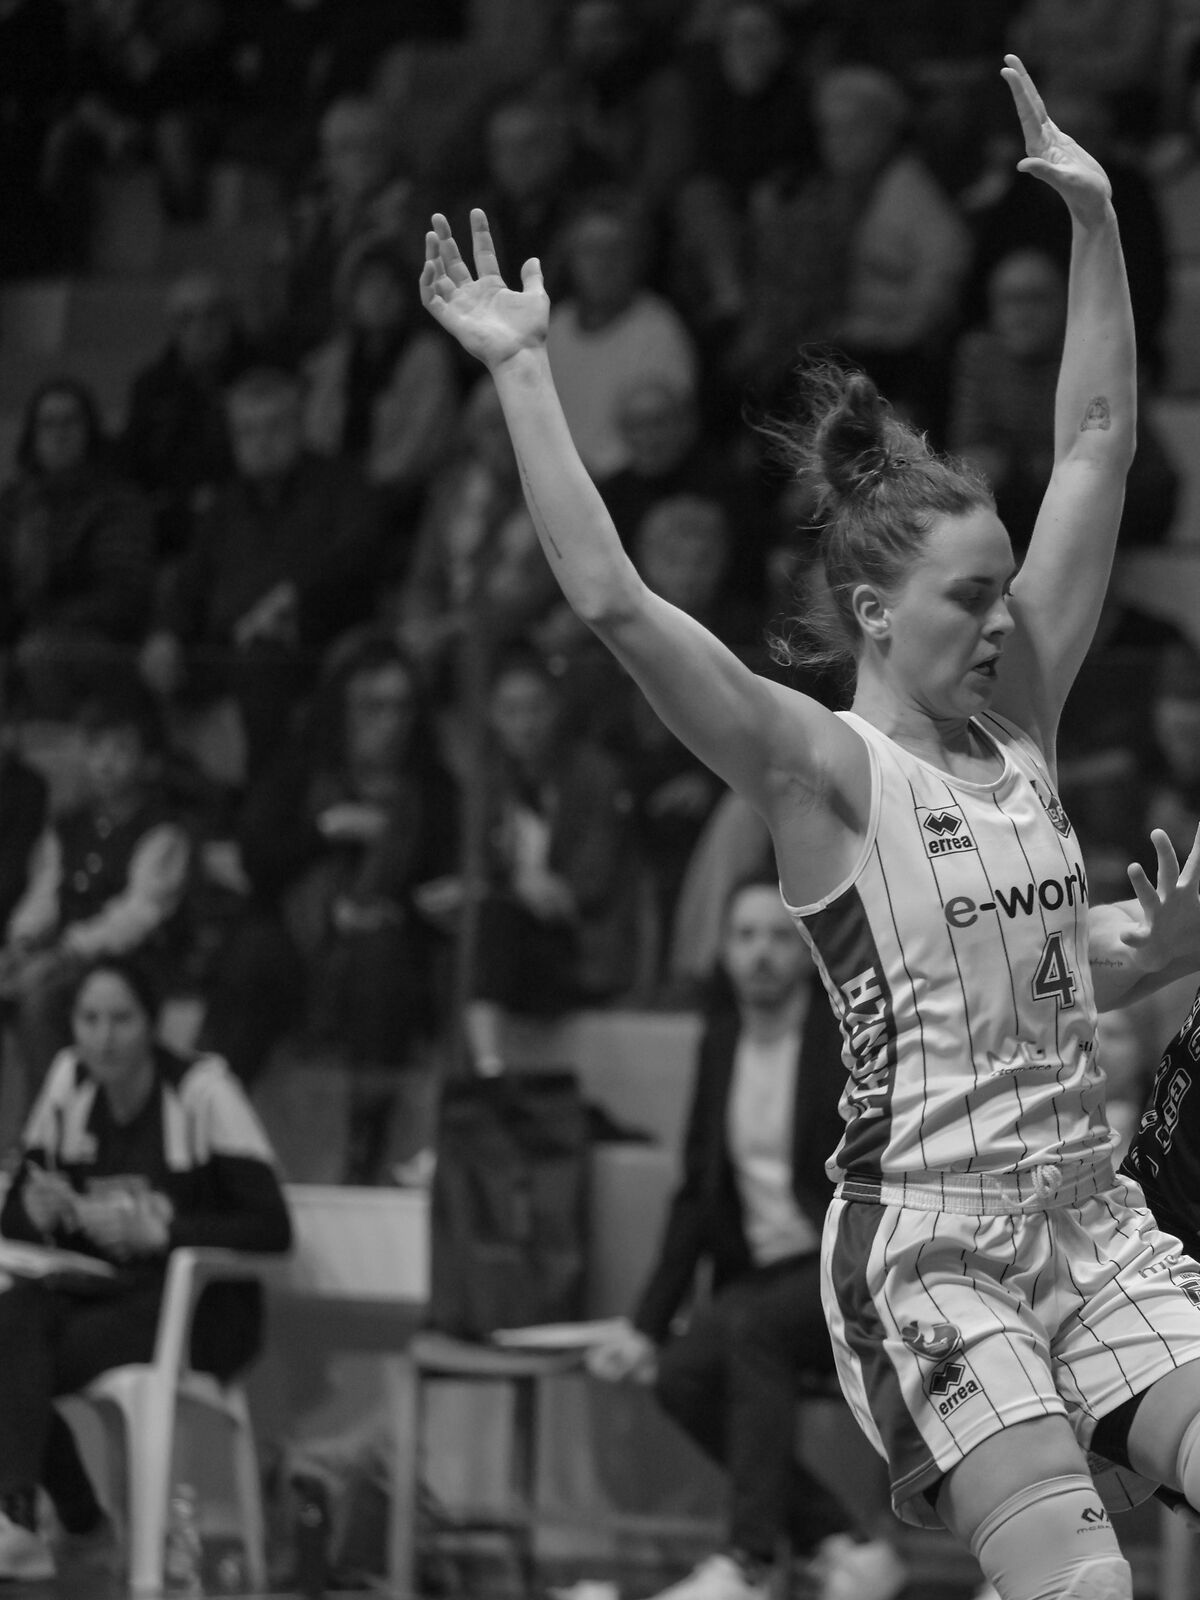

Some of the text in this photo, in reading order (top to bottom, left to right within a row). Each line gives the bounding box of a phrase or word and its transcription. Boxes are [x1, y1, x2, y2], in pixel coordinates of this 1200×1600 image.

[929, 835, 973, 855] errea
[944, 863, 1089, 928] e-work
[1032, 931, 1078, 1010] 4
[938, 1379, 979, 1416] errea
